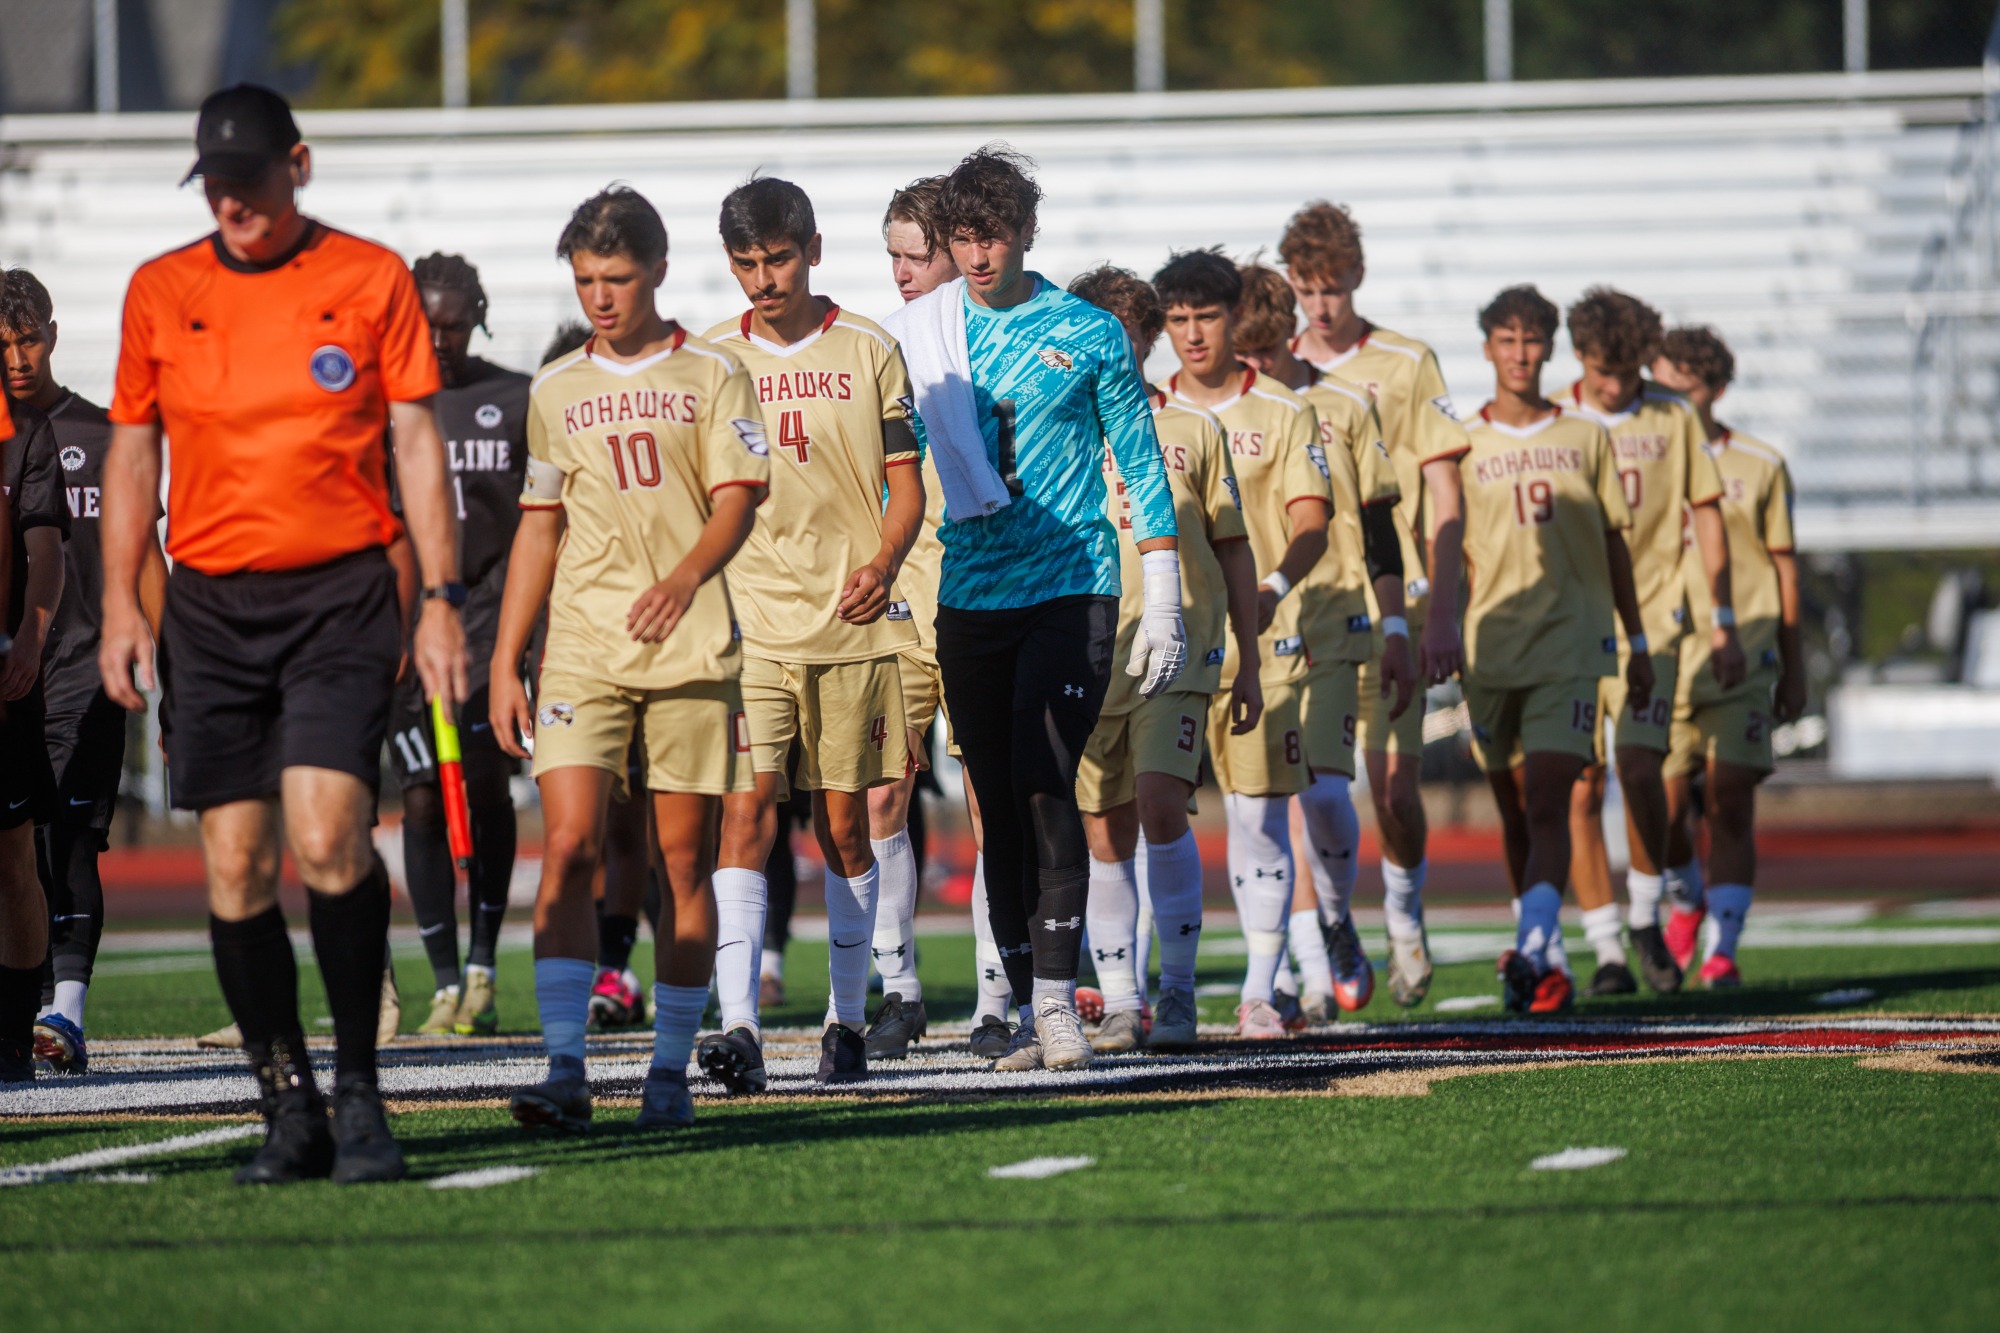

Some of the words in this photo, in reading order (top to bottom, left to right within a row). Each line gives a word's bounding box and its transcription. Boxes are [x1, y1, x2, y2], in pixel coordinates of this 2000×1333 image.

[757, 370, 853, 404] HAWKS
[564, 388, 698, 436] KOHAWKS
[447, 439, 512, 472] LINE
[778, 409, 811, 464] 4
[990, 398, 1024, 498] 1
[604, 430, 663, 492] 10
[1475, 446, 1581, 484] KOHAWKS
[65, 486, 101, 519] NE
[1514, 479, 1554, 527] 19
[870, 714, 888, 753] 4
[1177, 714, 1198, 754] 3
[1570, 698, 1597, 735] 19
[394, 725, 433, 774] 11
[1285, 729, 1301, 766] 8
